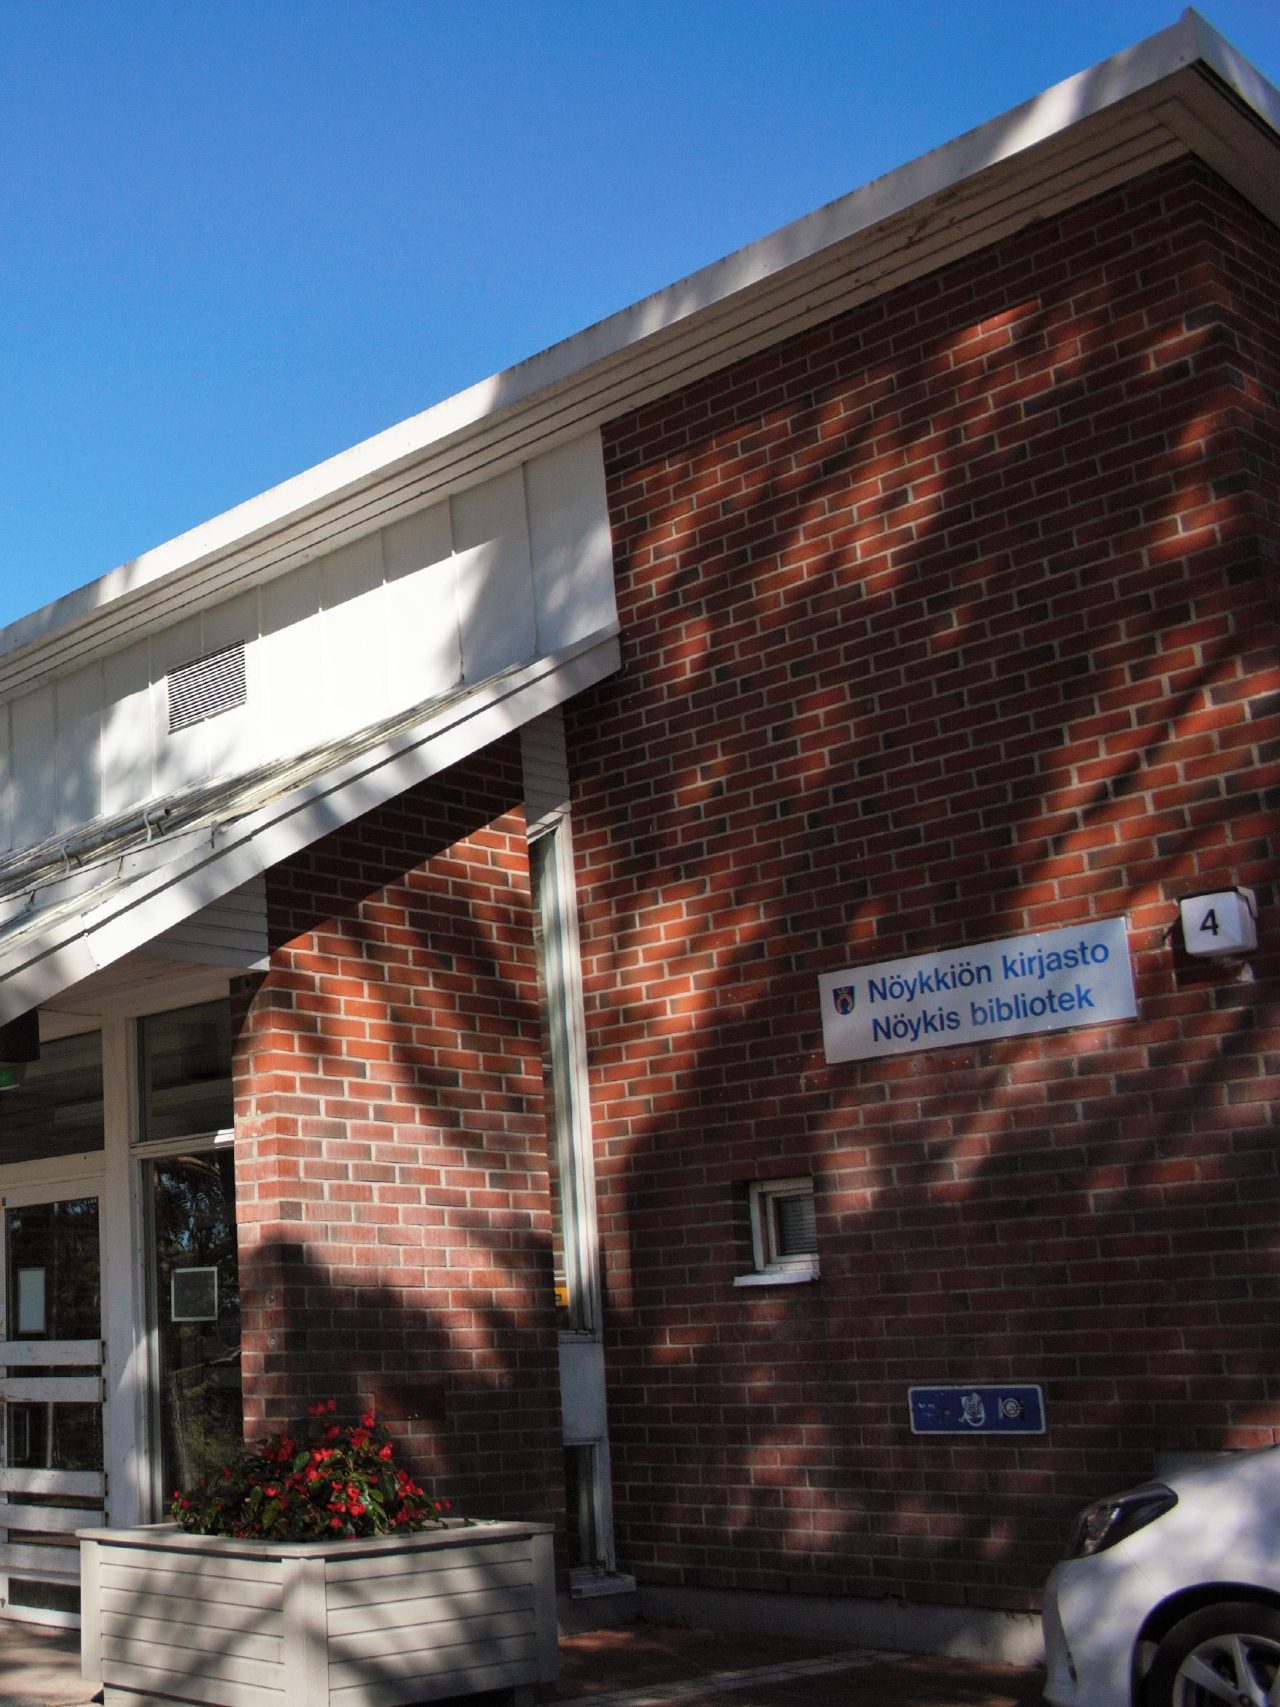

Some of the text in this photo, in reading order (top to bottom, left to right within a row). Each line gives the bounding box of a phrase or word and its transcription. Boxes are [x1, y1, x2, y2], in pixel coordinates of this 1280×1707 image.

[1199, 908, 1219, 936] 4
[868, 940, 1109, 1003] Nöykkiön kirjasto
[872, 983, 1095, 1042] Nöykis bibliotek
